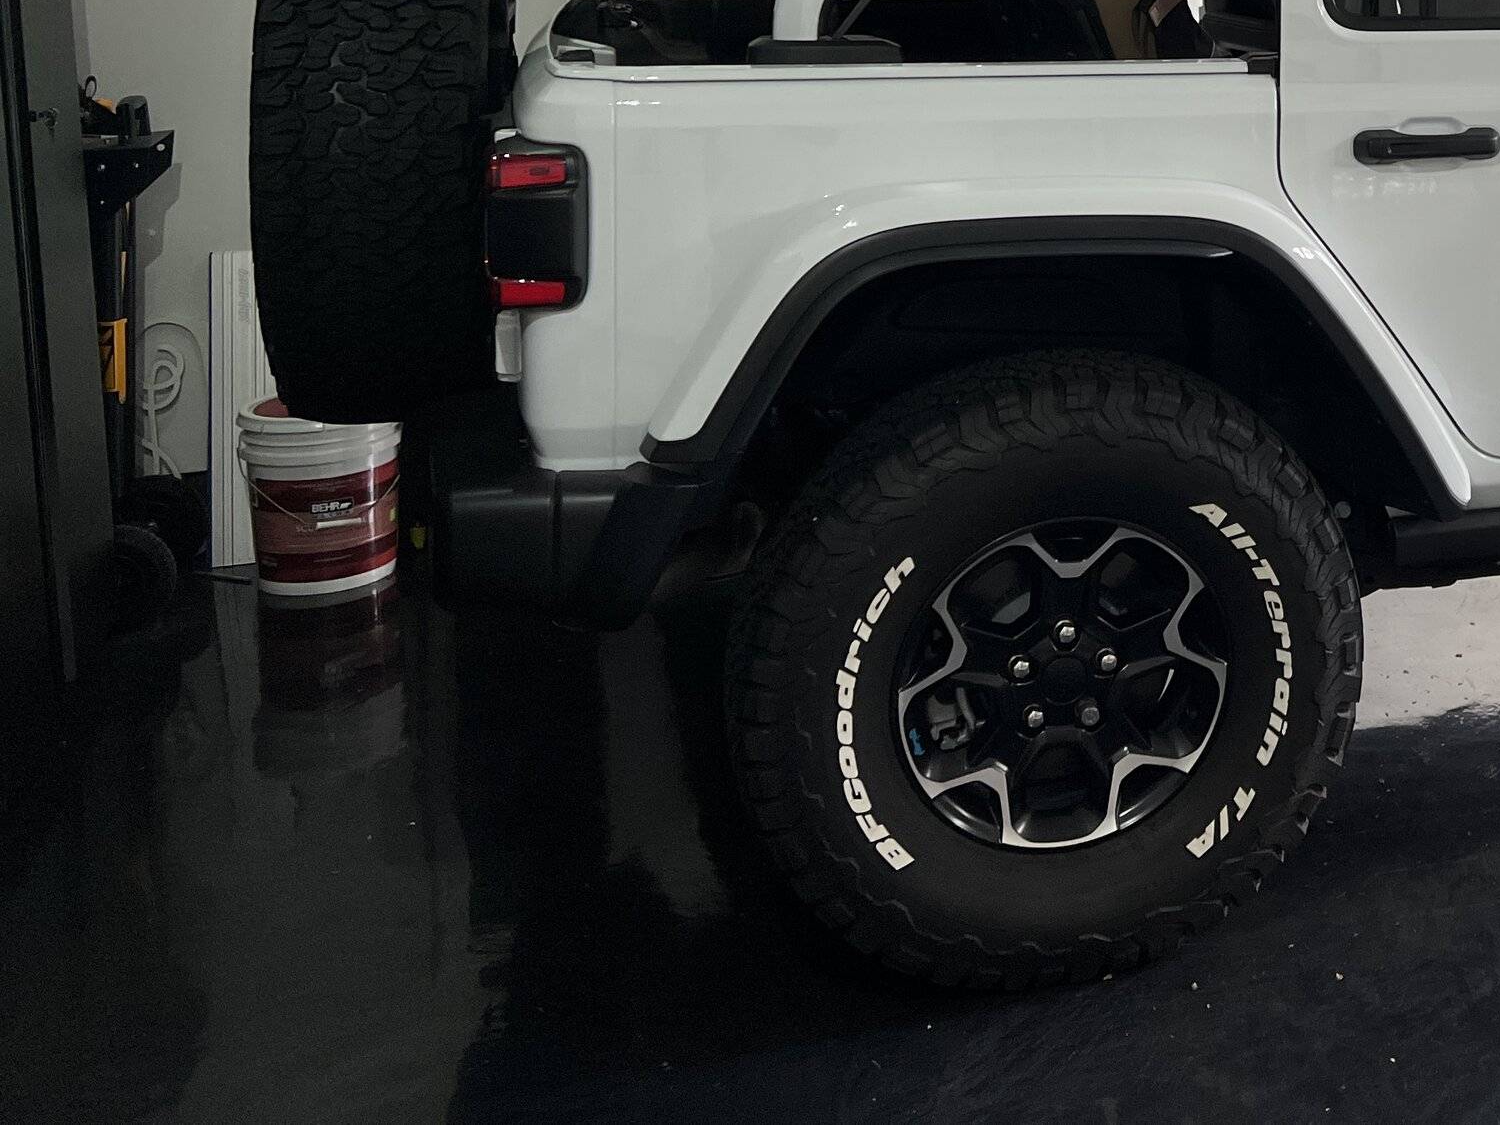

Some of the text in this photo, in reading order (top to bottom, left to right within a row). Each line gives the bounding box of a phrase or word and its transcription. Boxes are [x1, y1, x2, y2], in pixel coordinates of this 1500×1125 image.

[311, 501, 341, 514] BEHR
[836, 556, 915, 871] BFGoodrich
[1186, 502, 1294, 859] All-Terrain T/A
